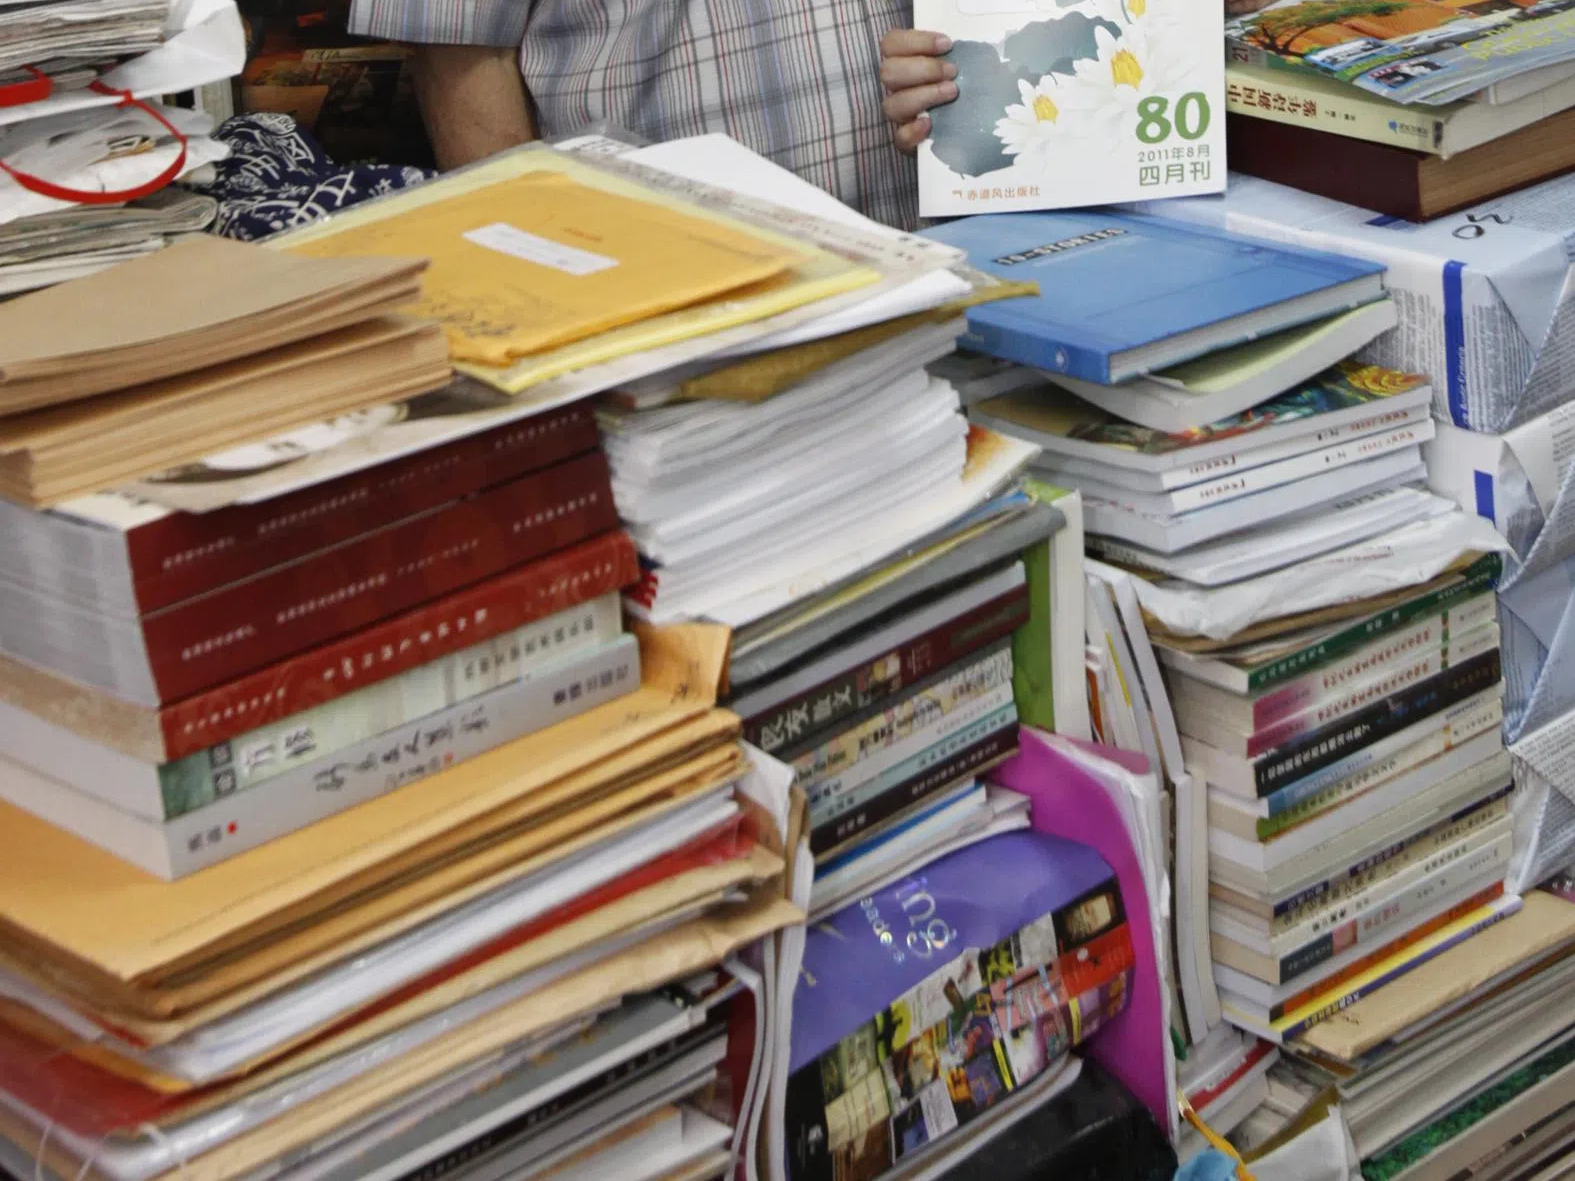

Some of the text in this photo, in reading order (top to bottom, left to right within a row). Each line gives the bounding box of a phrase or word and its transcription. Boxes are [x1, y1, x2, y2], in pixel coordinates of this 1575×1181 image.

[1135, 90, 1211, 145] 80
[1137, 143, 1211, 163] 2011年8月
[1138, 160, 1211, 187] 四月刊
[966, 185, 1041, 201] 赤道风出版社
